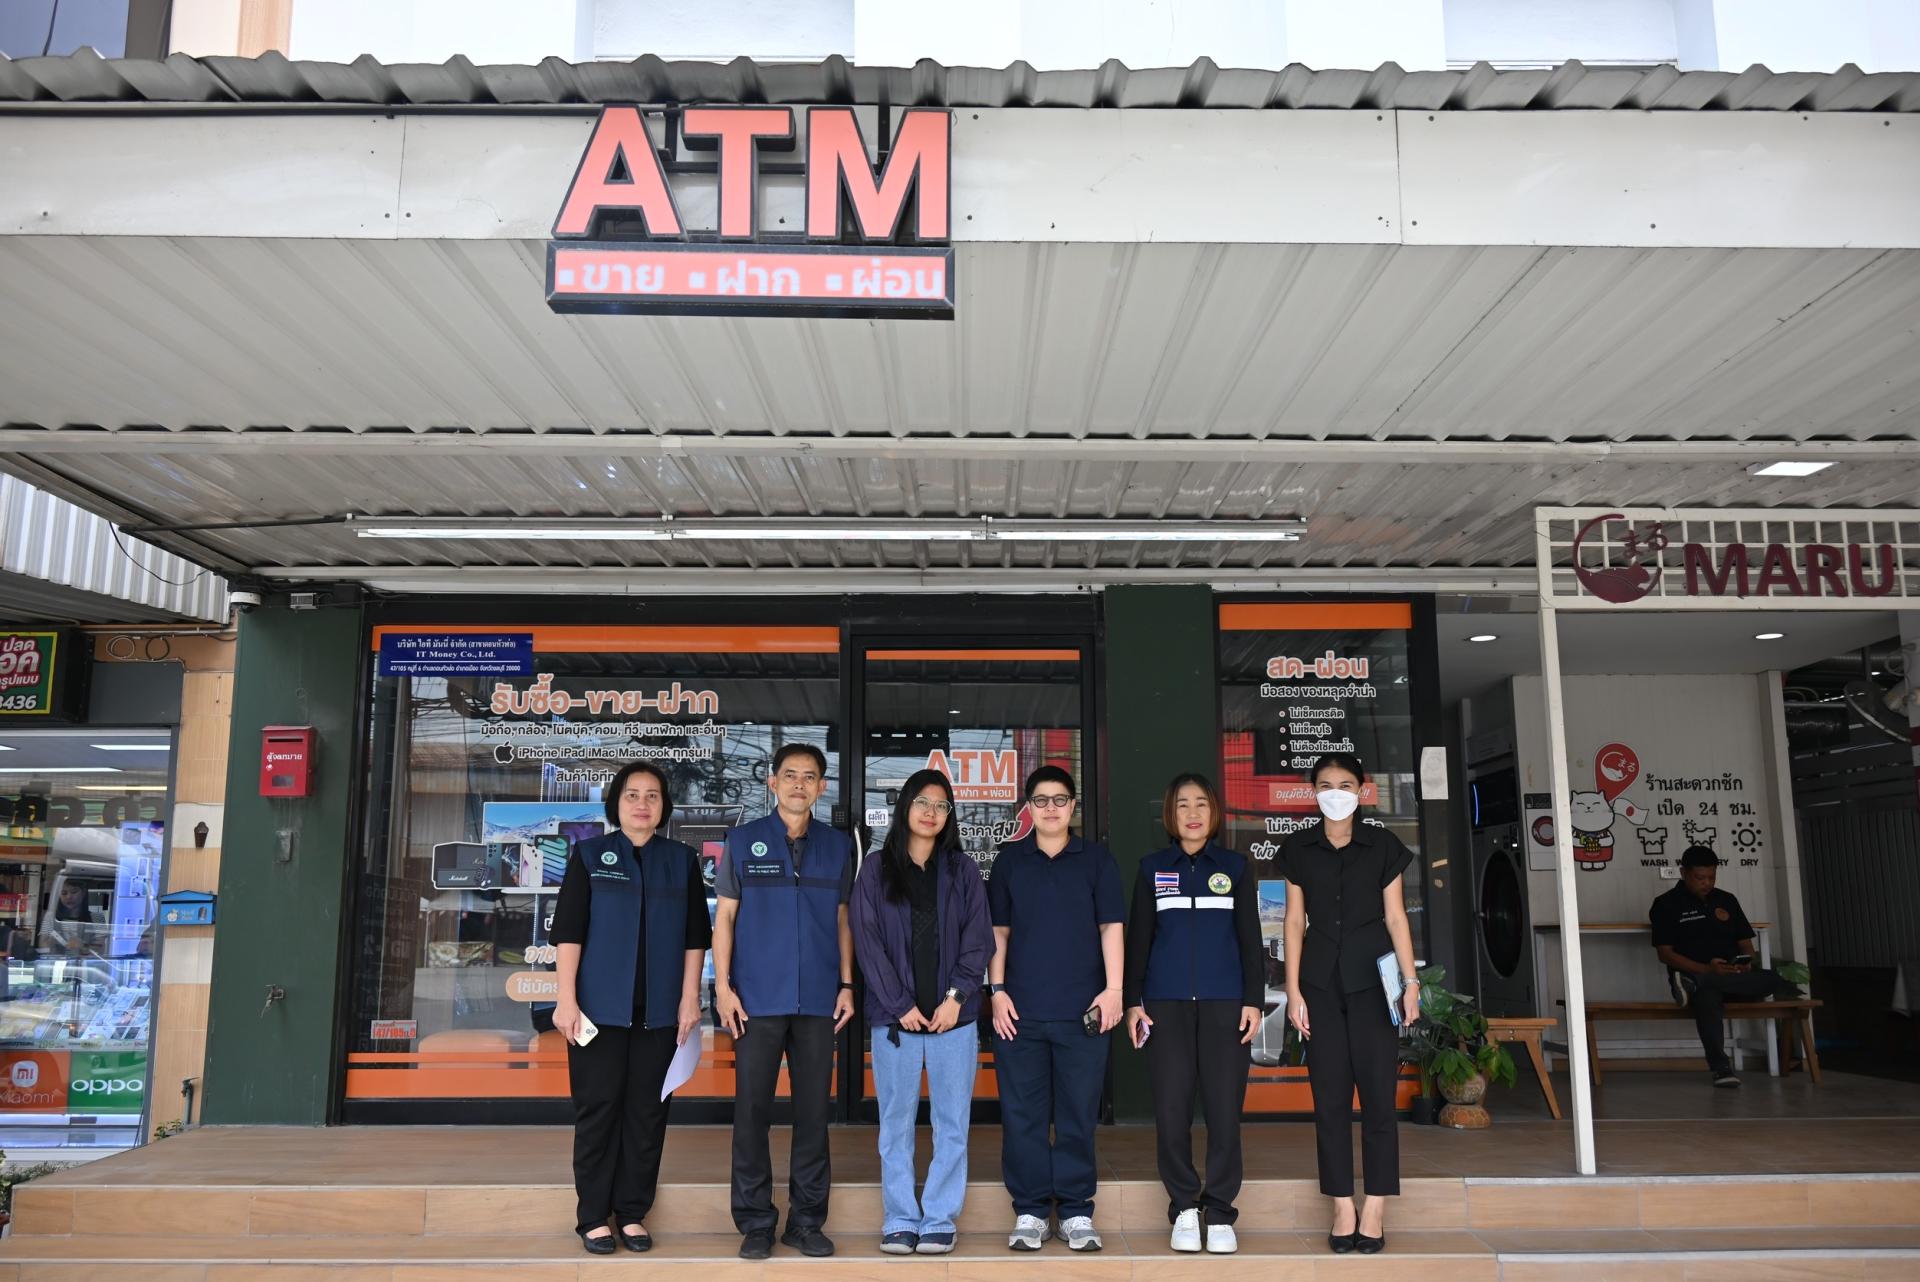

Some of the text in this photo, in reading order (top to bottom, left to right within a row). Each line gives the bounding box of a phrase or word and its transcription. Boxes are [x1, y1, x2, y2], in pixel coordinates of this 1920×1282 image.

[551, 104, 952, 243] ATM
[583, 258, 942, 299] ขาย ฝาก ผ่อน
[1683, 543, 1895, 597] MARU
[397, 639, 417, 648] บริษัท
[450, 639, 466, 648] จำกัด
[429, 651, 457, 659] Money
[1267, 650, 1369, 679] สด-ผ่อน
[0, 674, 39, 689] รูปแบบ
[491, 674, 719, 714] รับซื้อ-ขาย-ฝาก
[1260, 683, 1377, 701] มือสอง ของหลุดจำนำ
[481, 723, 515, 736] มือถือ,
[518, 723, 549, 736] กล้อง,
[645, 723, 683, 736] นาฬิกา
[685, 719, 727, 737] และอื่นๆ
[518, 746, 712, 762] iPhone iPad iMac Macbook ทุกรุ่น!!
[1646, 773, 1743, 792] ร้านสะดวกซัก
[1657, 799, 1756, 816] เปิด 24 ชม.
[957, 820, 1016, 844] ราคาสูง
[1641, 859, 1669, 867] WASH
